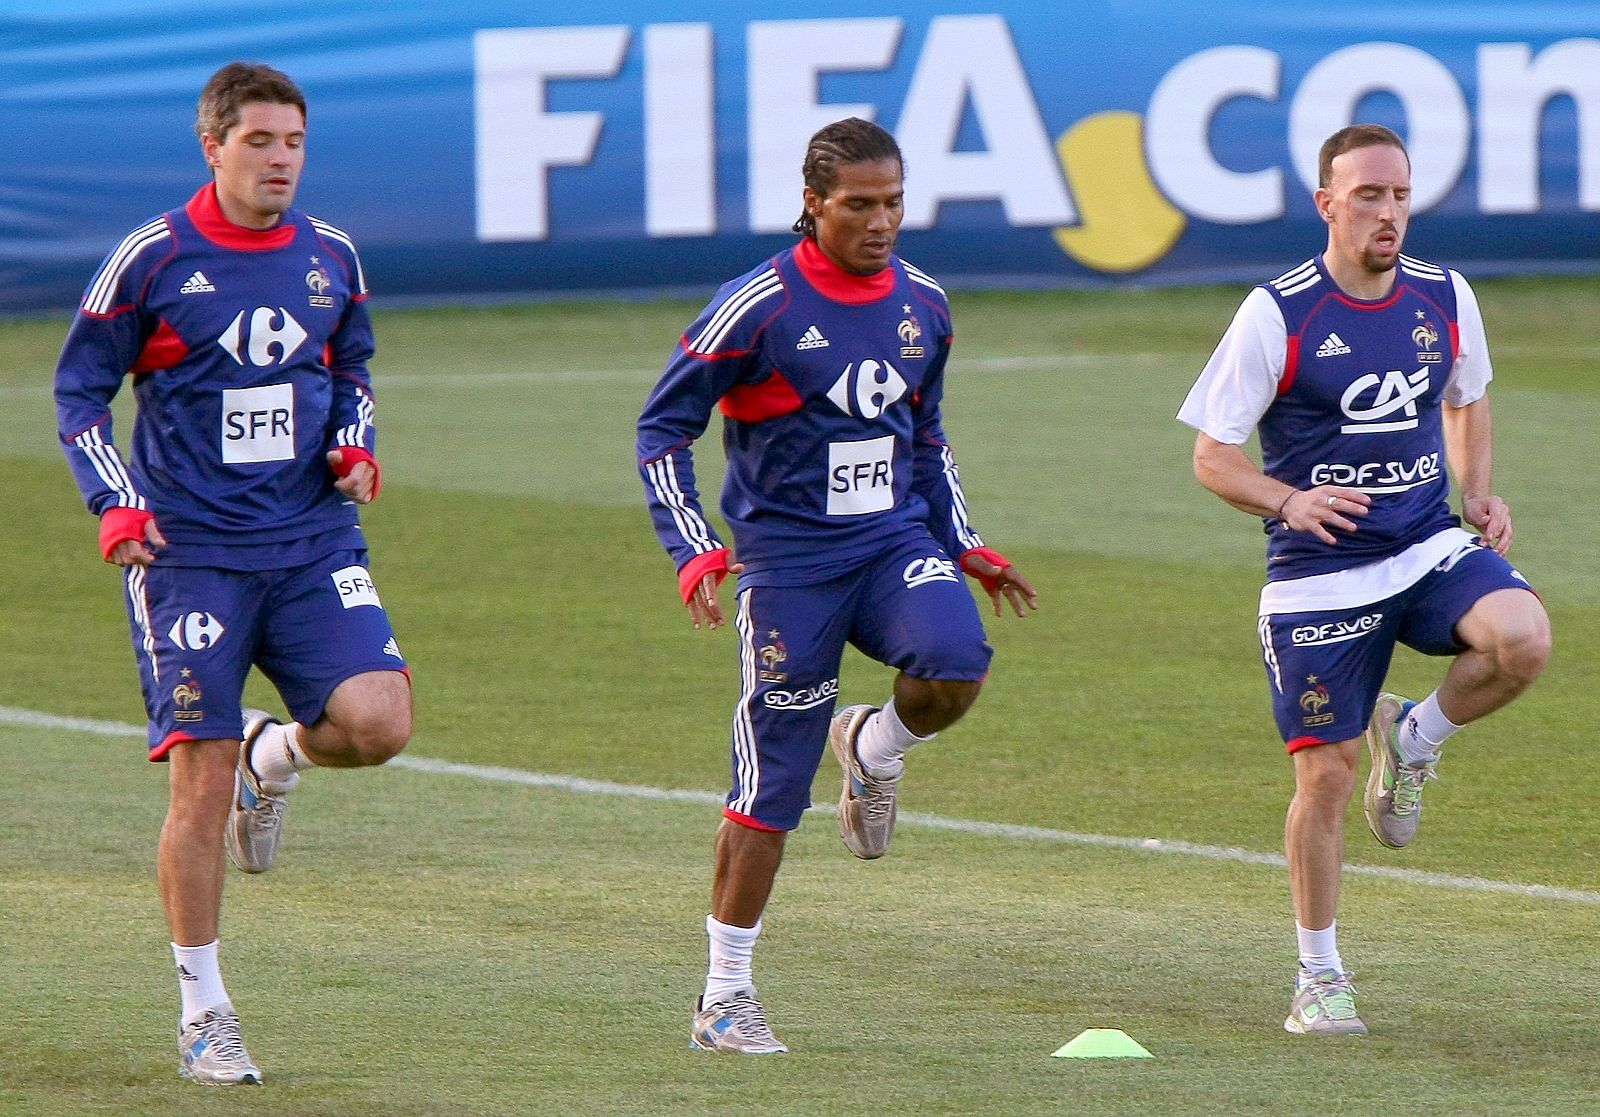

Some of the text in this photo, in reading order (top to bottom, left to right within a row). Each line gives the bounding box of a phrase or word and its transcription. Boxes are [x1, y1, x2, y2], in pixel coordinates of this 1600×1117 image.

[179, 283, 216, 295] adidas
[796, 338, 830, 351] adidas
[1315, 344, 1352, 358] adidas
[225, 407, 291, 441] SFR
[830, 459, 889, 493] SFR
[1310, 462, 1381, 485] GDF
[1291, 623, 1334, 644] GDF
[763, 689, 807, 707] GDF
